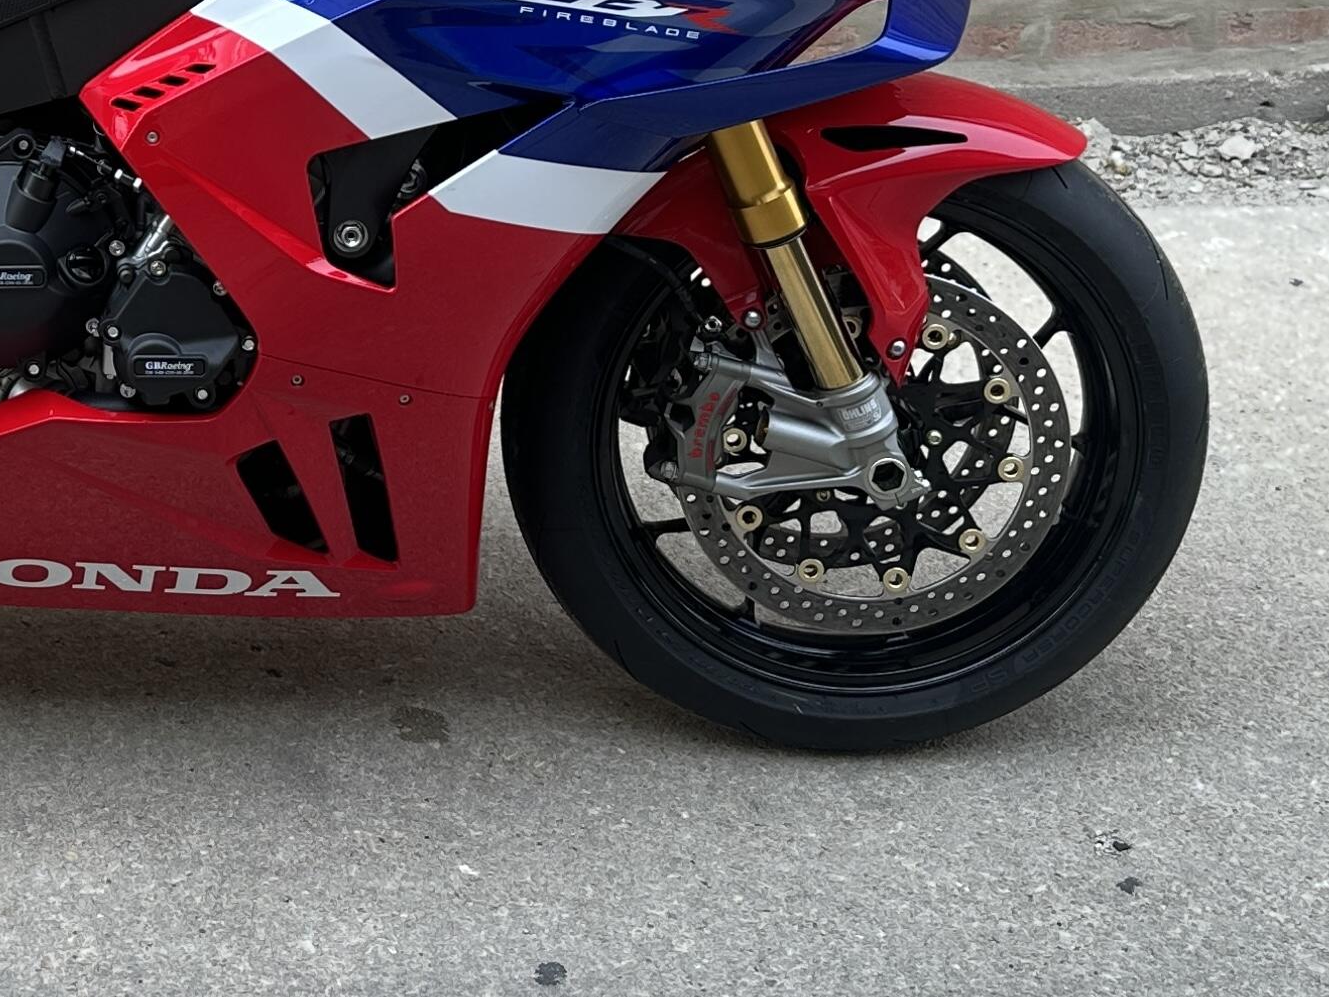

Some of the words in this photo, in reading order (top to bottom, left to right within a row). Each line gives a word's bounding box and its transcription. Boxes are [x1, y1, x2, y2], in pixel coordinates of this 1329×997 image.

[519, 6, 700, 39] FIREBLADE
[145, 361, 194, 372] GBRacing
[688, 391, 720, 460] brembo
